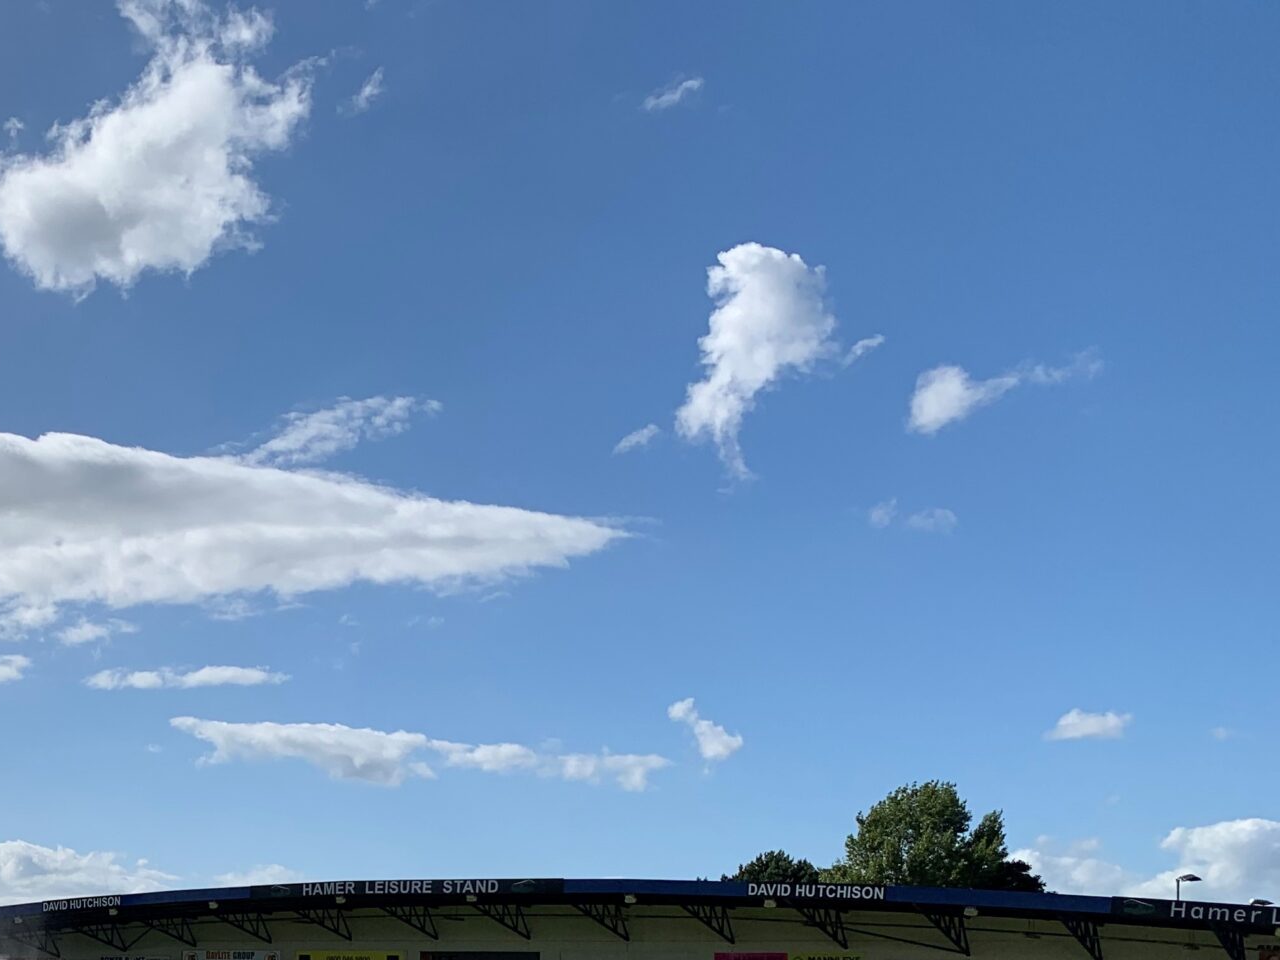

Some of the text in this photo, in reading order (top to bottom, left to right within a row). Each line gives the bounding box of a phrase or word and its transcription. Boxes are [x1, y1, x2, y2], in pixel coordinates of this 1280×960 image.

[302, 880, 499, 896] HAMER LEISURE STAND
[747, 883, 885, 900] DAVID HUTCHISON
[43, 896, 120, 912] DAVID HUTCHISON
[1170, 902, 1262, 924] Hamer
[206, 951, 255, 960] DAYLITE GROUP
